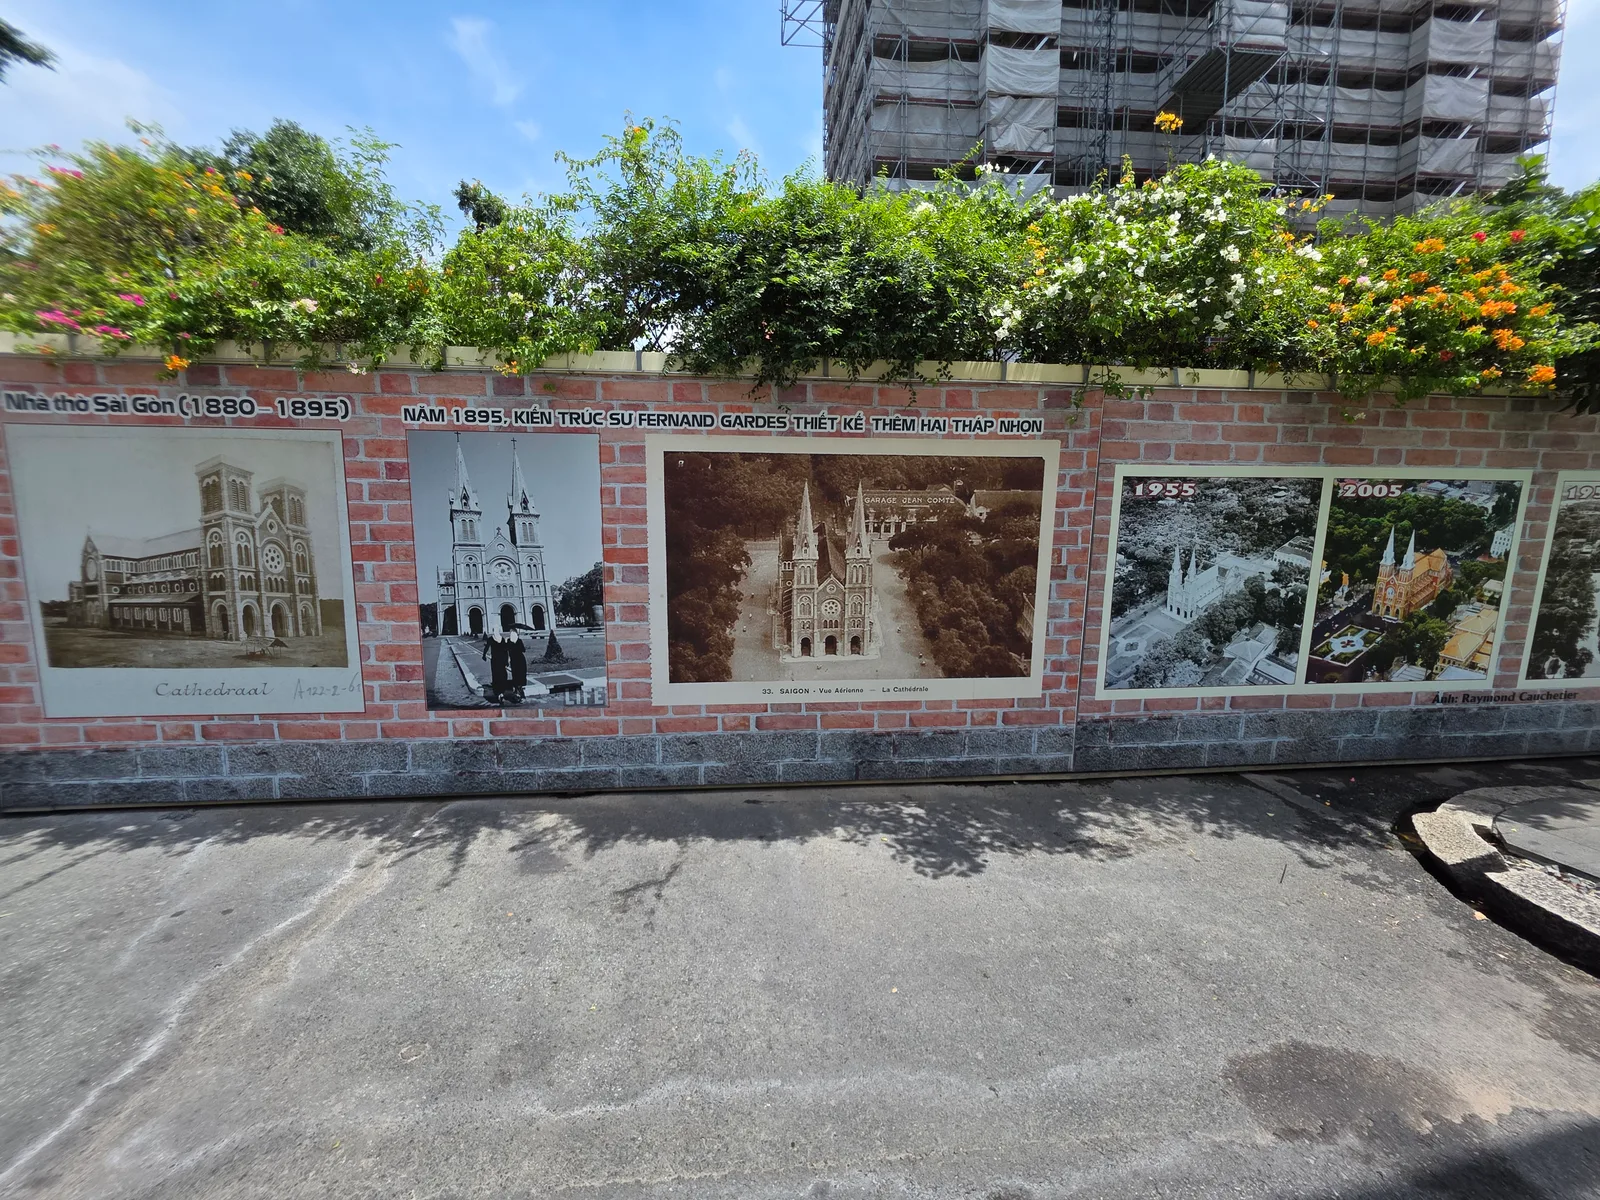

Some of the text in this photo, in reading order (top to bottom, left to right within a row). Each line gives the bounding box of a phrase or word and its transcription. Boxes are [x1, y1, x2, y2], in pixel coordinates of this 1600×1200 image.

[5, 392, 50, 411] Nhà
[93, 395, 128, 412] Sài
[132, 396, 175, 413] Gòn
[403, 404, 445, 422] NĂM
[453, 409, 508, 425] 1895,
[514, 407, 551, 425] KIẾN
[558, 408, 603, 426] TRÚC
[638, 413, 715, 428] FERNAND
[721, 415, 787, 429] GARDES
[793, 411, 838, 430] THIẾT
[844, 413, 863, 430] KẾ
[872, 415, 915, 432] THÊM
[921, 418, 947, 432] HAI
[952, 417, 994, 432] THÁP
[1000, 418, 1042, 436] NHỌN
[1134, 483, 1197, 496] 1955
[1343, 484, 1403, 497] 2005
[155, 682, 274, 697] Cathedraal
[565, 688, 604, 705] LIFE
[1462, 692, 1516, 704] Raymond
[1519, 690, 1578, 702] Cauchetier
